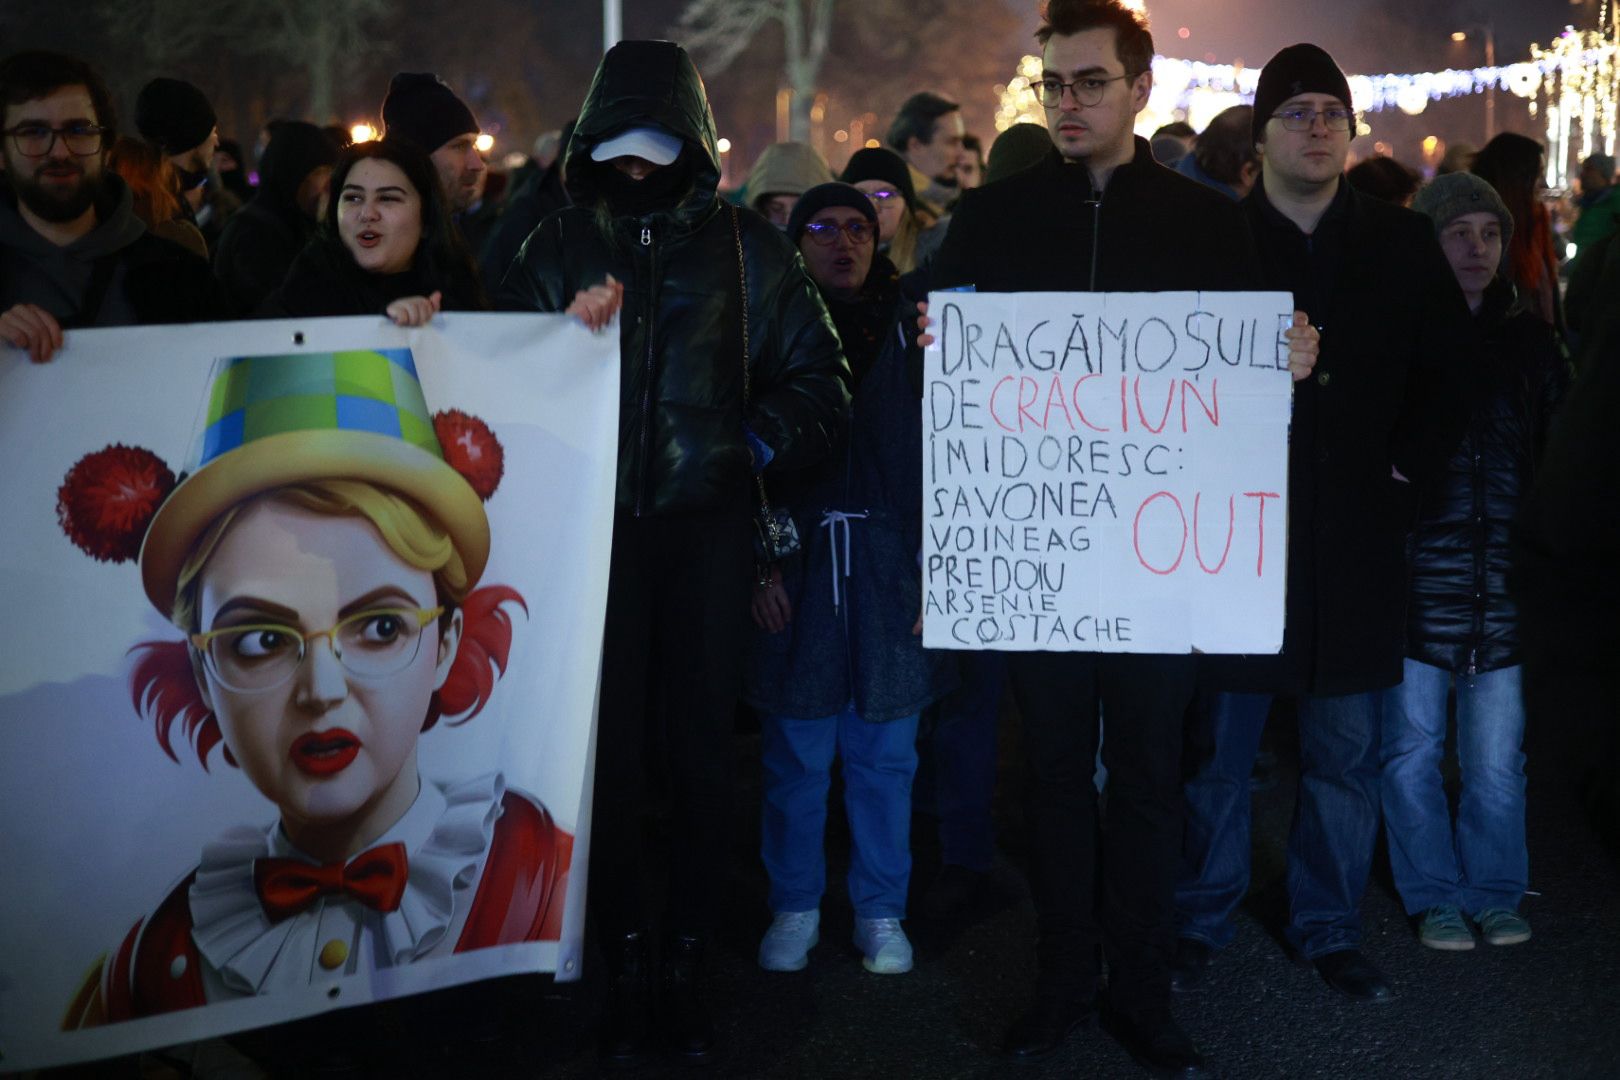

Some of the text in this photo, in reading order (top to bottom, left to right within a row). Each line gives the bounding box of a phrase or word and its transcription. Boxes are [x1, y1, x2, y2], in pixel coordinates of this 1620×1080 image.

[990, 371, 1220, 434] CRĂCIUN
[931, 482, 1118, 522] SAVONEA
[930, 525, 1092, 553] VOINEAG
[1132, 491, 1281, 577] OUT
[928, 555, 1066, 595] PREDOIU
[925, 591, 1058, 616] ARSENIE
[951, 614, 1133, 645] COSTACHE
